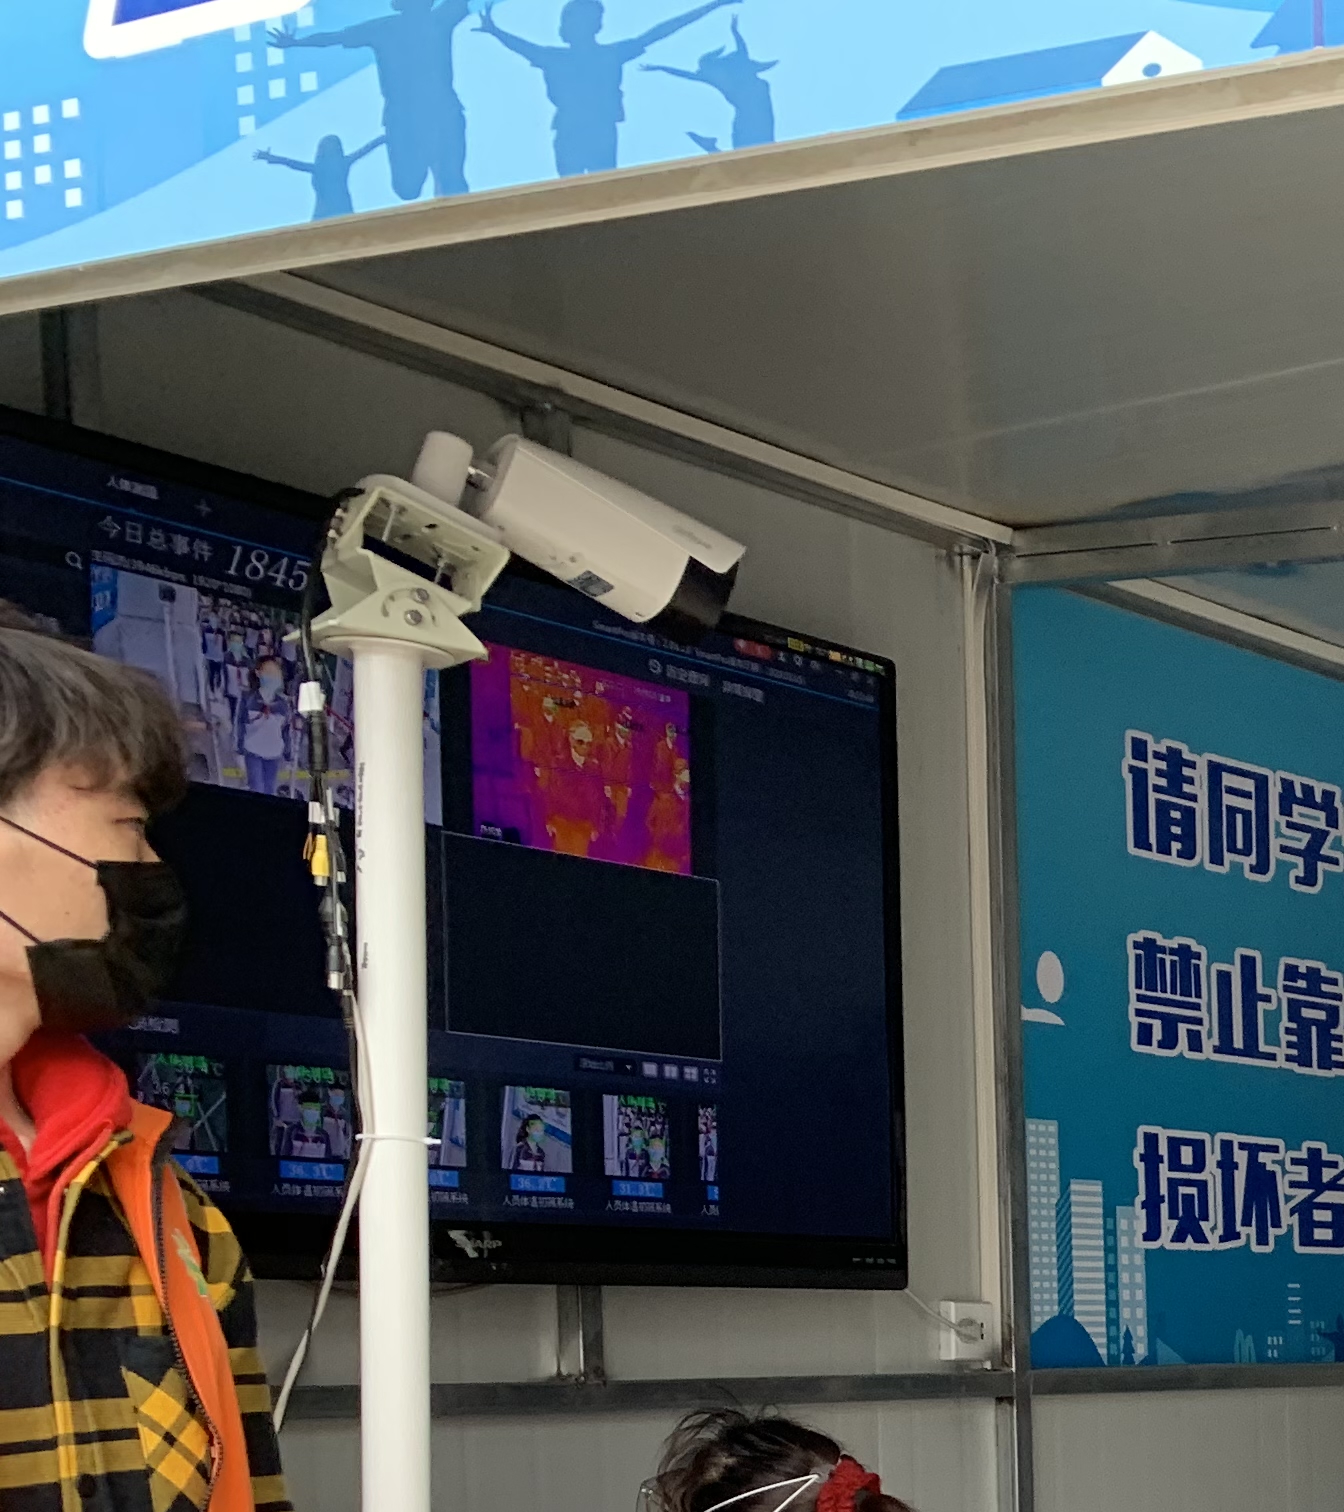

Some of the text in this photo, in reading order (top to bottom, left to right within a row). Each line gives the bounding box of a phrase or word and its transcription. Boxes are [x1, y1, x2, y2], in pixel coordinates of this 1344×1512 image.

[98, 515, 214, 562] 今日总事件
[225, 544, 313, 592] 1845
